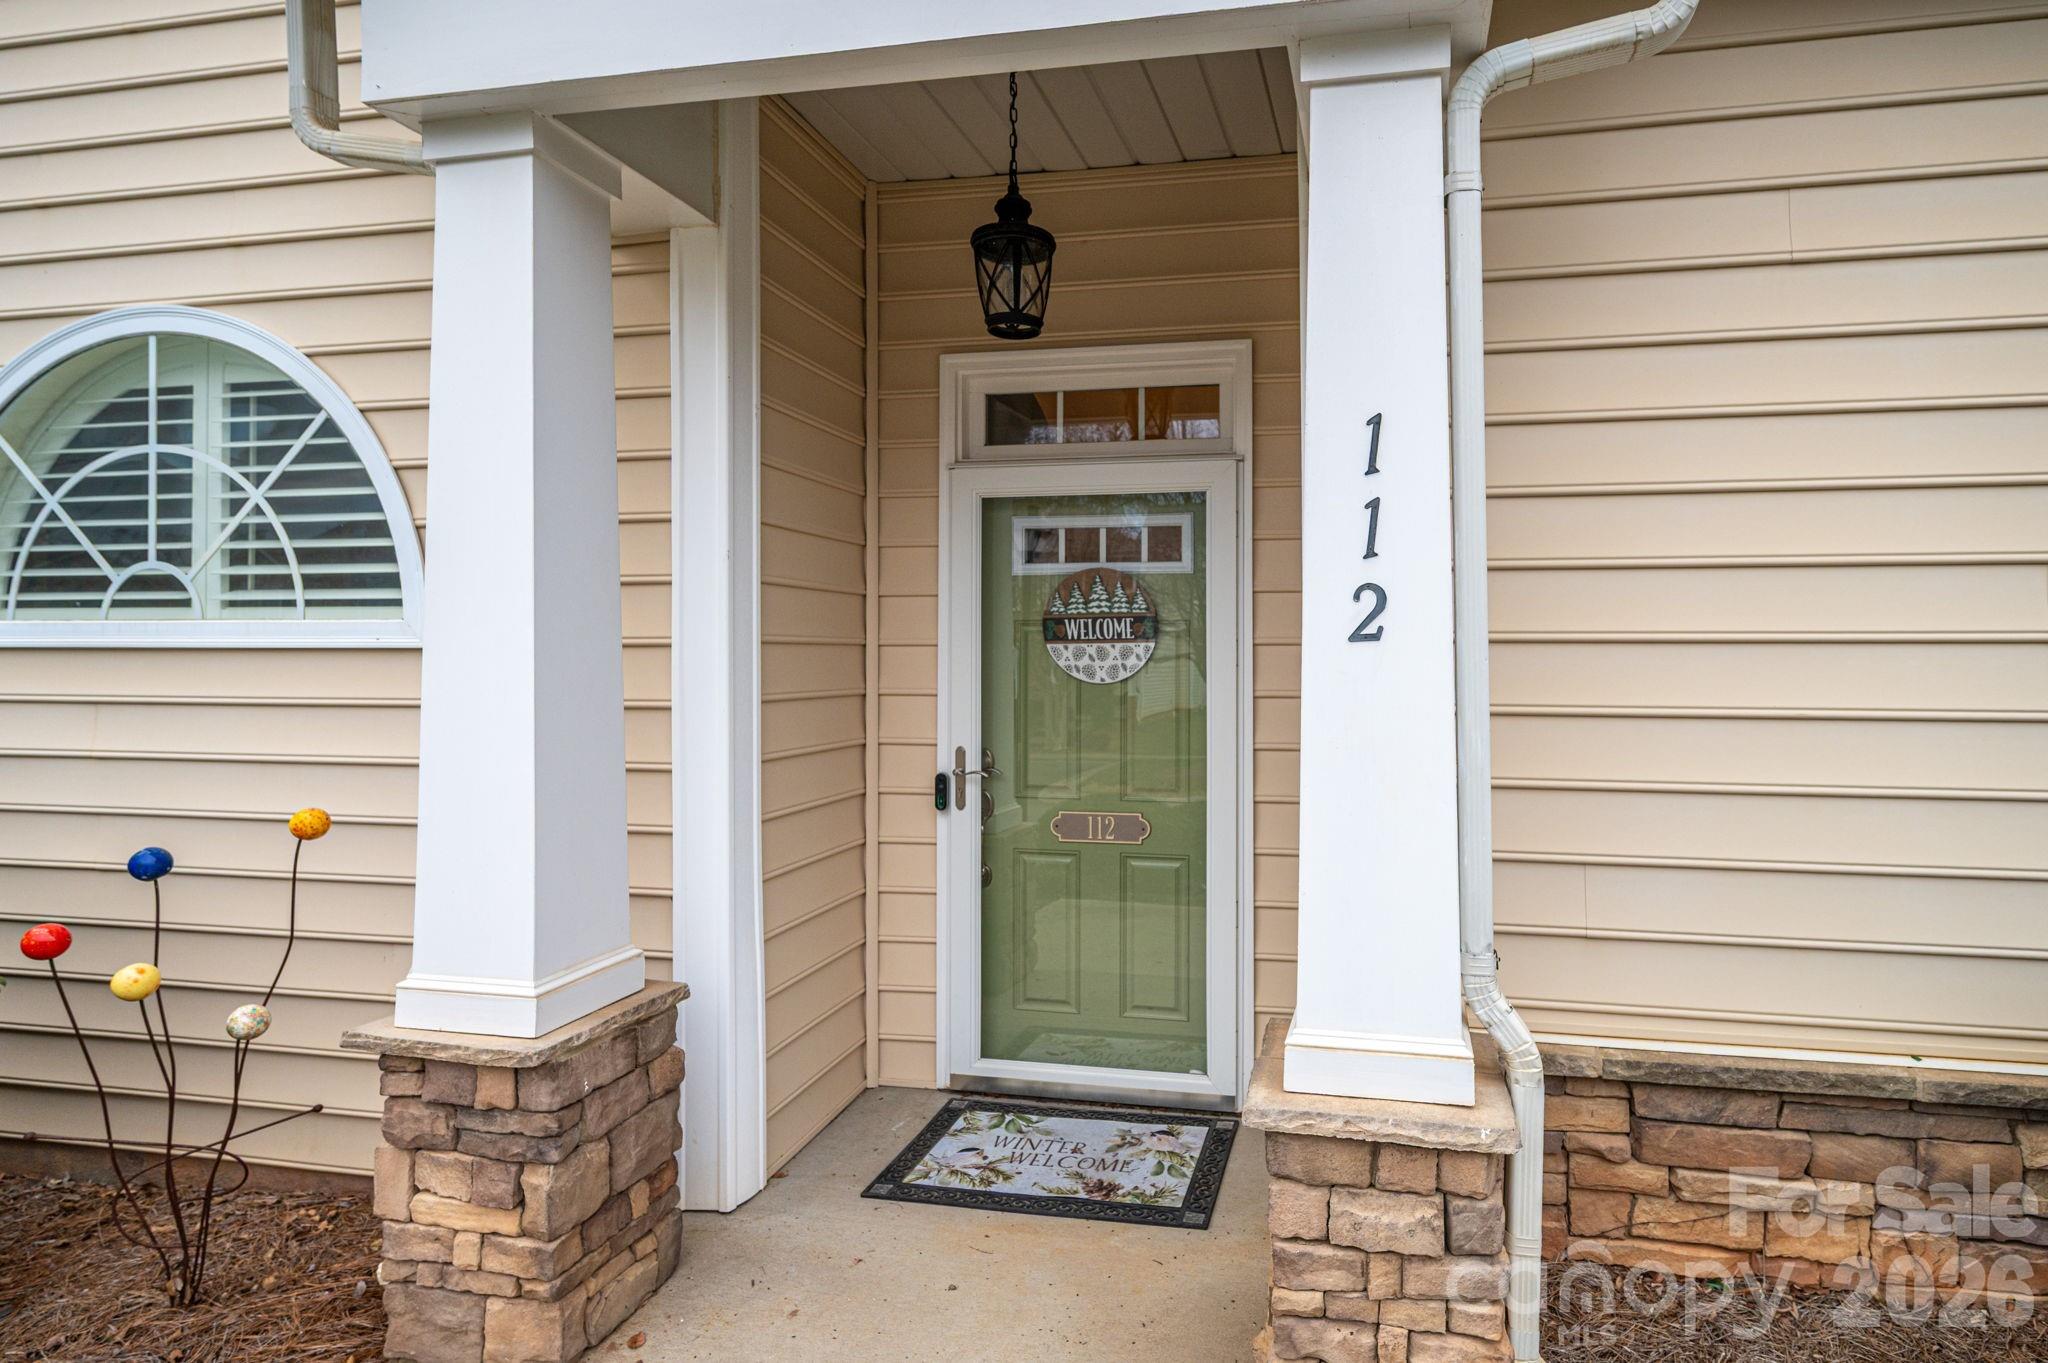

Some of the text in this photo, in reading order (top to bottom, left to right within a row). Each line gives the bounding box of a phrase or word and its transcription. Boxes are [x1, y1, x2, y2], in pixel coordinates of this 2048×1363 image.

[1347, 412, 1388, 643] 112
[1064, 617, 1135, 640] WELCOME
[1087, 816, 1115, 840] 112
[993, 1135, 1087, 1155] WINTER
[1009, 1151, 1136, 1173] WELCOME
